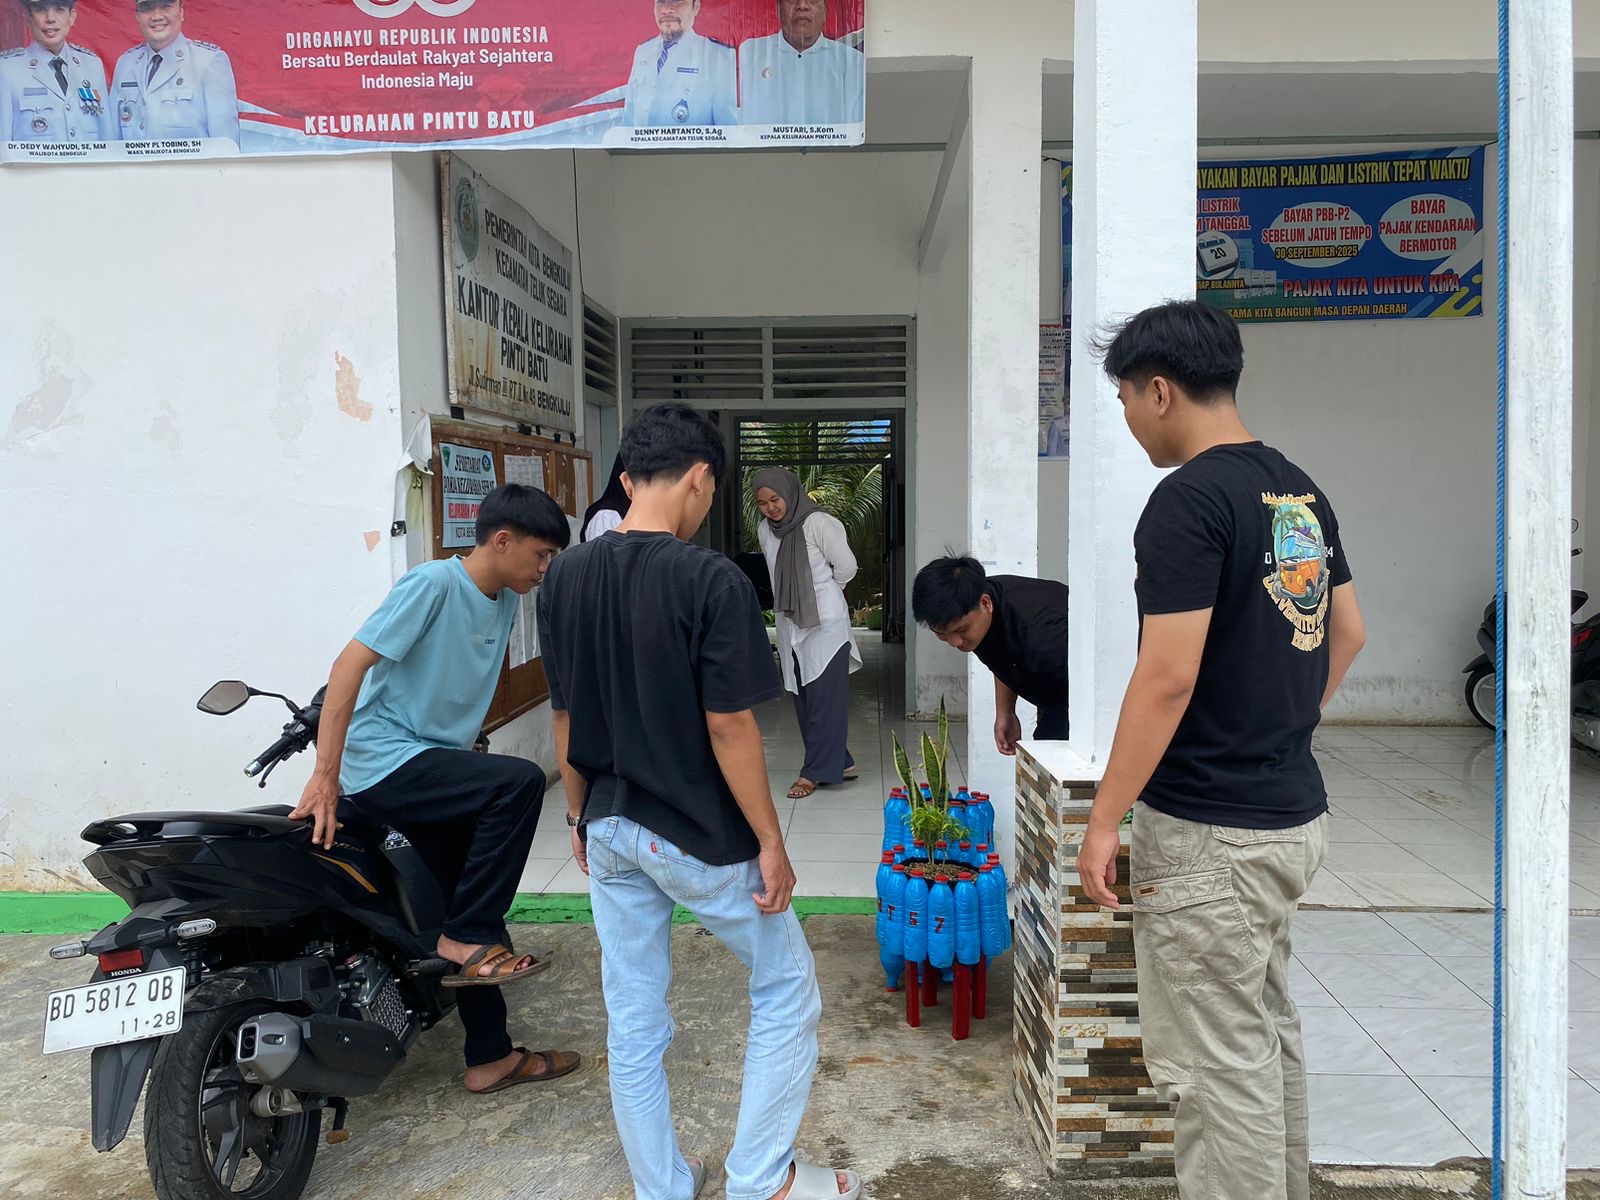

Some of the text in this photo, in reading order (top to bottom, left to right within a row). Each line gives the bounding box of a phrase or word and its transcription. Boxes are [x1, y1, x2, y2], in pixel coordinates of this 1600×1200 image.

[286, 26, 549, 50] DIRGAHAYU REPUBLIK INDONESIA
[282, 47, 553, 69] Bersatu Berdaulat Rakyat Sejahtera
[362, 71, 474, 90] Indonesia Maju
[304, 110, 535, 135] KELURAHAN PINTU BATU
[634, 128, 659, 136] BENNY
[1241, 166, 1277, 188] BAYAR
[1281, 165, 1317, 186] PAJAK
[1320, 163, 1344, 184] DAN
[1347, 161, 1390, 184] LISTRIK
[1393, 160, 1427, 182] TEPAT
[1429, 158, 1470, 180] WAKTU
[1202, 198, 1239, 212] LISTRIK
[1411, 200, 1446, 215] BAYAR
[1205, 216, 1250, 230] TANGGAL
[1284, 207, 1350, 222] BAYAR PBB-P2
[1262, 225, 1372, 243] SEBELUM JATUH TEMPO
[1380, 218, 1476, 235] PAJAK KENDARAAN
[485, 208, 571, 292] PEMERINTAH KOTA BENGKULU
[1210, 247, 1227, 260] 20
[1275, 245, 1358, 259] 30 SEPTEMBER 2025
[1400, 237, 1457, 253] BERMOTOR
[495, 248, 567, 318] KECAMATAN TELUK SEGARA
[1284, 274, 1460, 298] PAJAK KITA UNTUK KITA
[1255, 308, 1273, 317] KITA
[1275, 307, 1311, 317] BANGUN
[1314, 306, 1339, 316] MASA
[1342, 305, 1370, 315] DEPAN
[1373, 303, 1407, 314] DAERAH
[457, 274, 572, 366] KANTOR KEPALA KELURAHAN
[501, 336, 548, 383] PINTU BATU
[537, 390, 571, 417] BENGKULU
[111, 967, 142, 977] HONDA
[50, 993, 75, 1021] BD
[85, 982, 137, 1014] 5812
